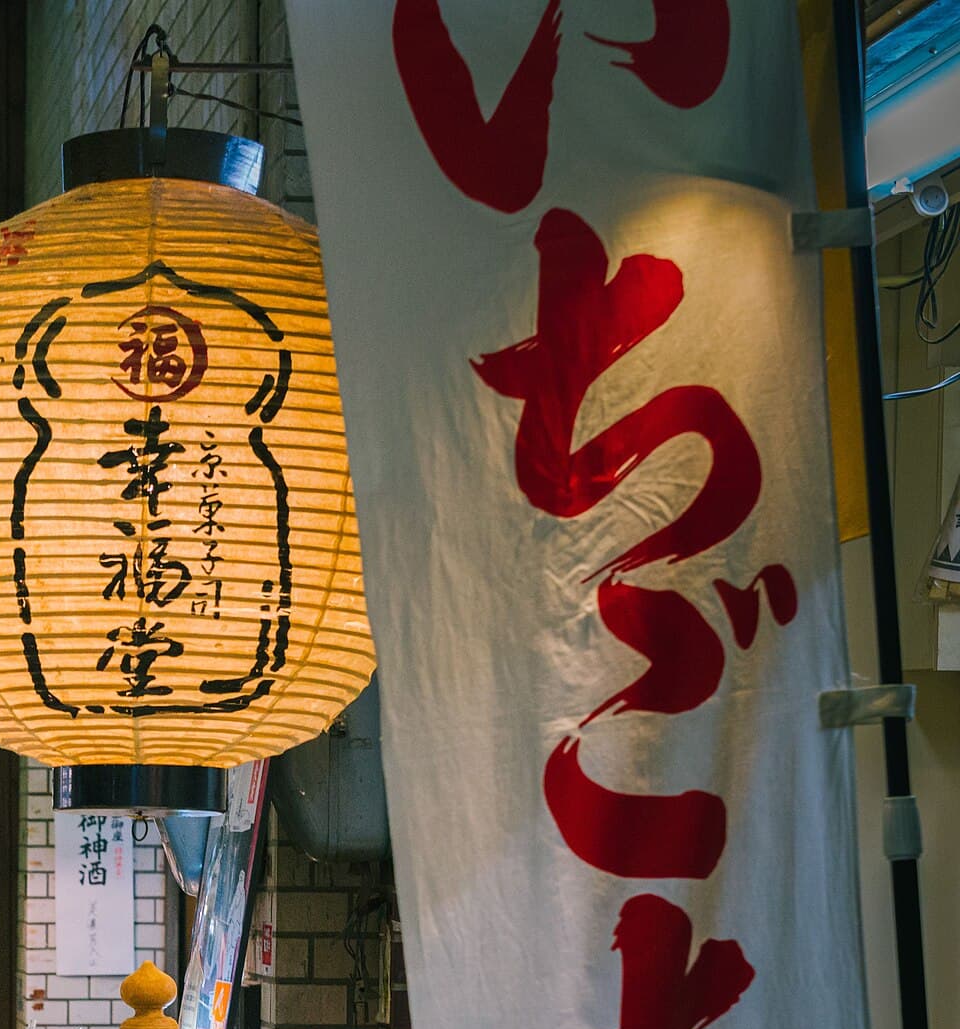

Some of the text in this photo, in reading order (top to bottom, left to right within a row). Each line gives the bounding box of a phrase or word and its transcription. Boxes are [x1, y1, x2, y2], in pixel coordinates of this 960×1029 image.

[117, 320, 188, 389] 福
[96, 404, 192, 698] 幸福堂
